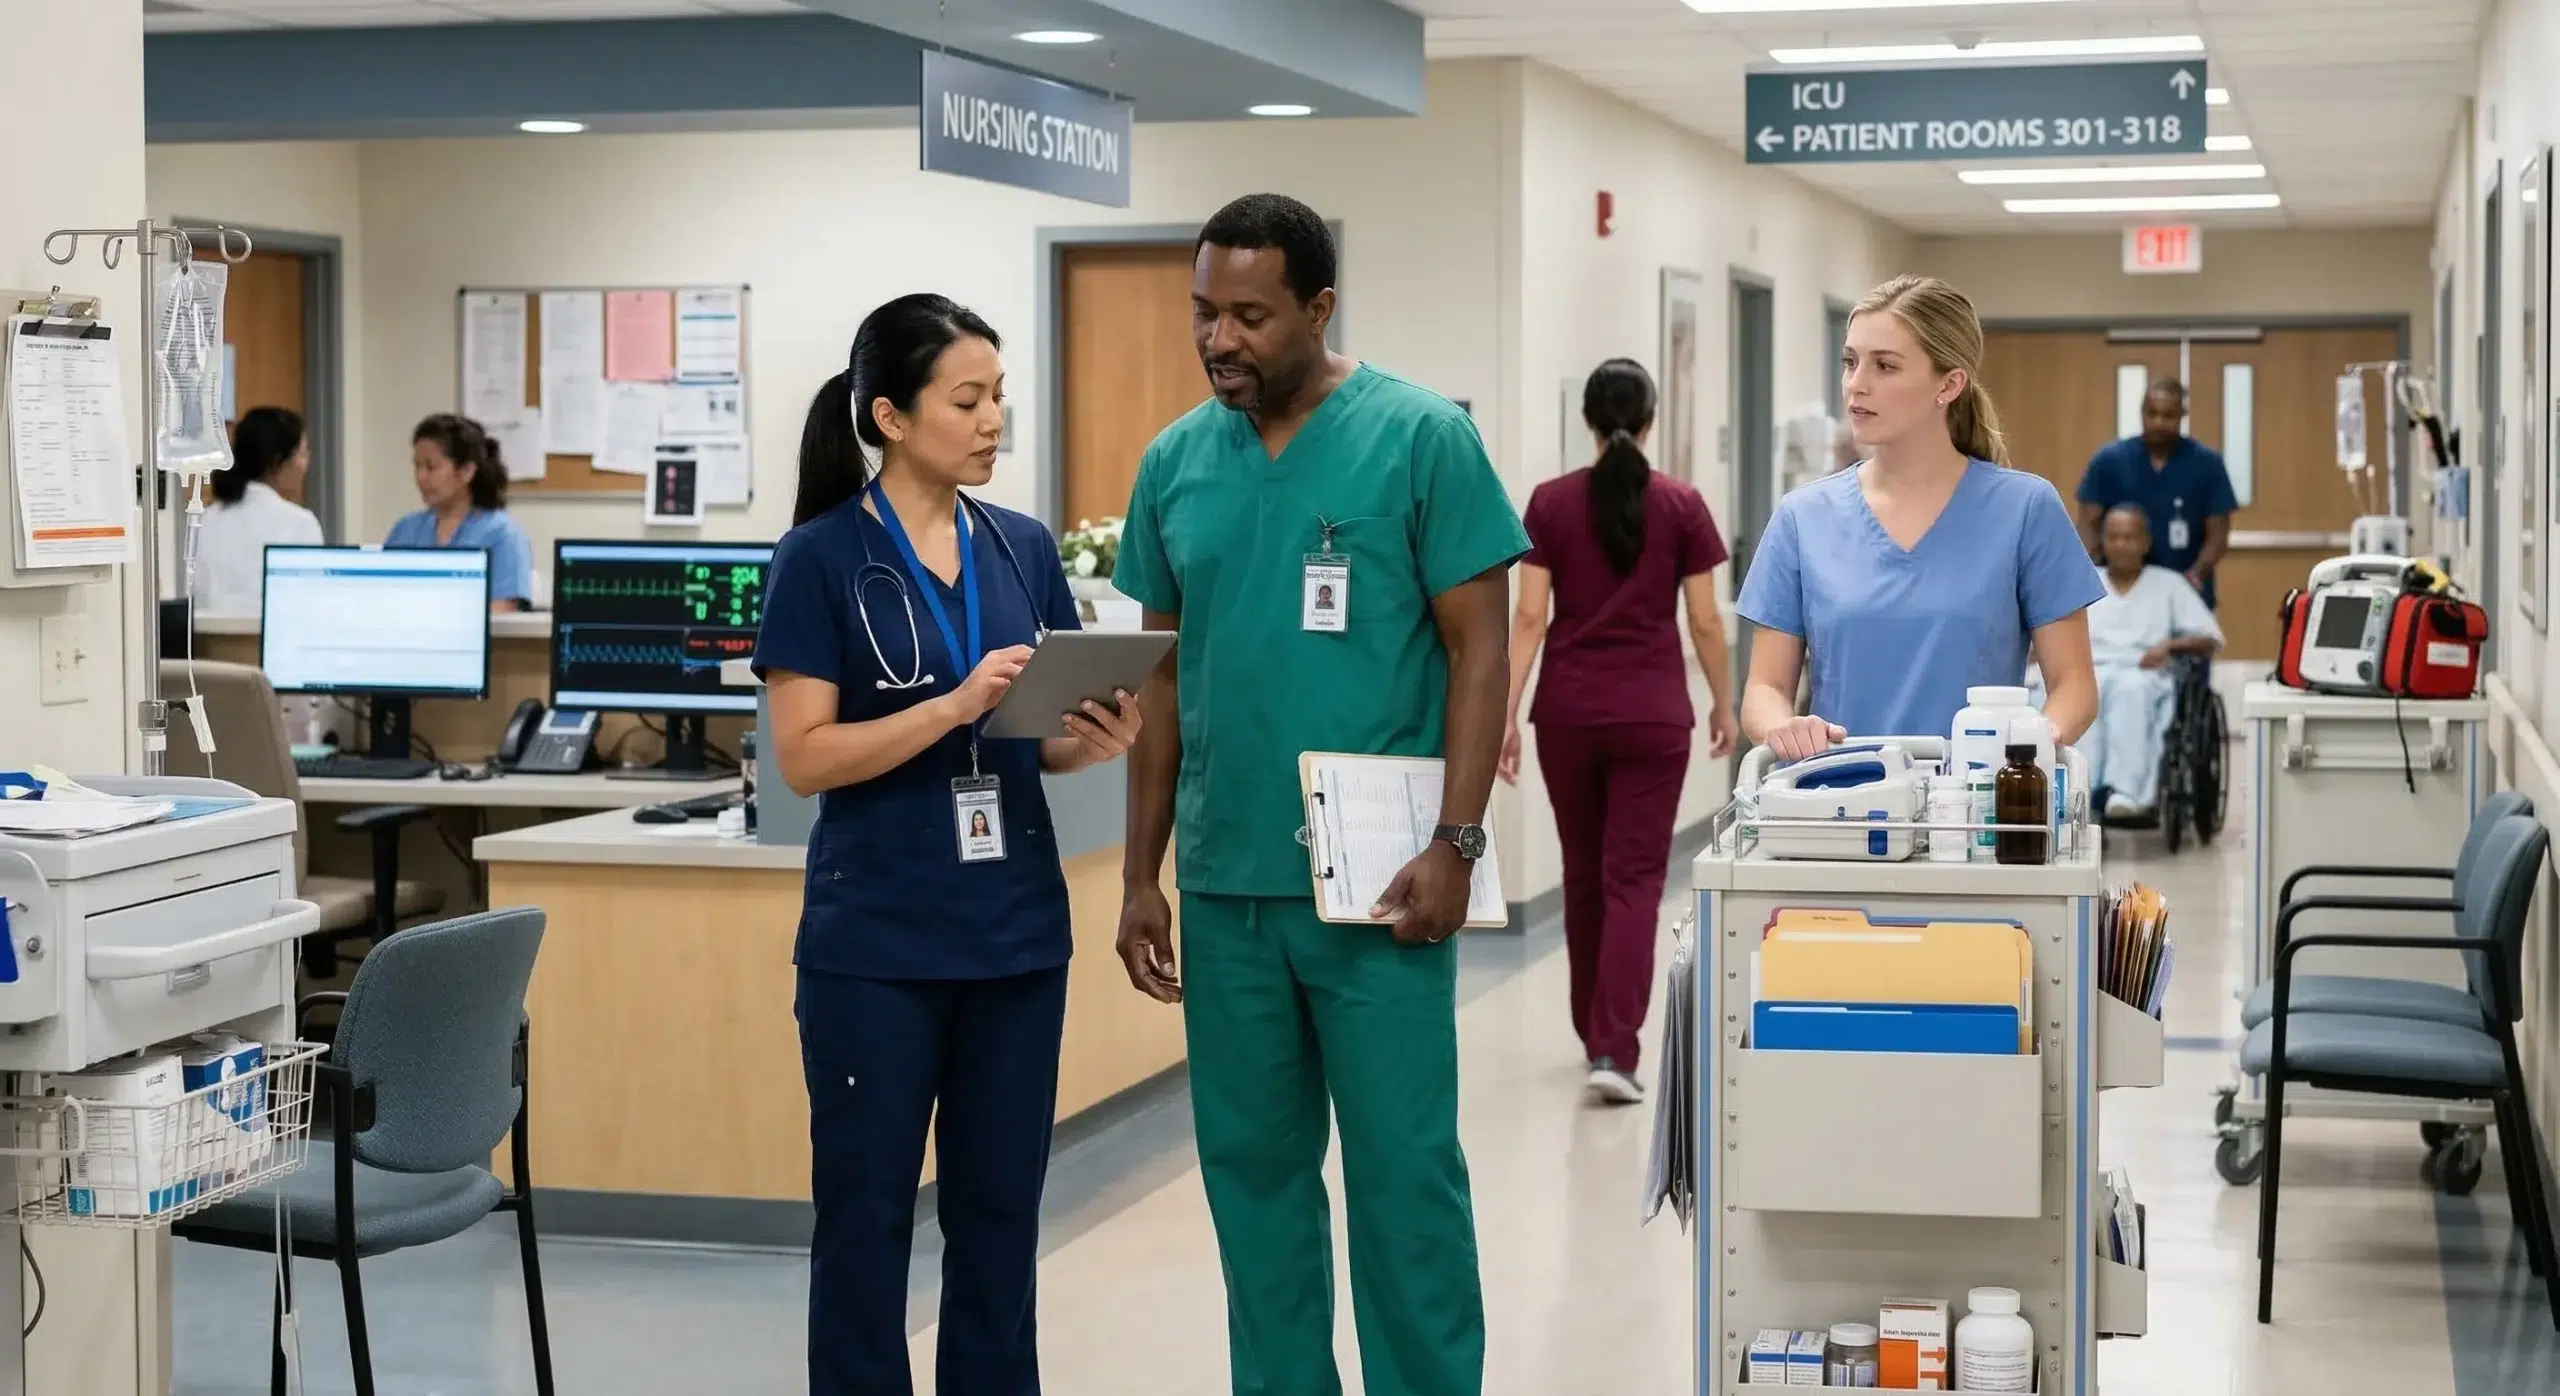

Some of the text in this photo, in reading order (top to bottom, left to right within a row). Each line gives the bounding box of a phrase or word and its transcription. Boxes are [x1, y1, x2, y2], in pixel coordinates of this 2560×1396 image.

[1792, 82, 1846, 110] ICU
[943, 91, 1120, 176] NURSING STATION
[1793, 115, 2182, 152] PATIENT ROOMS 301-318
